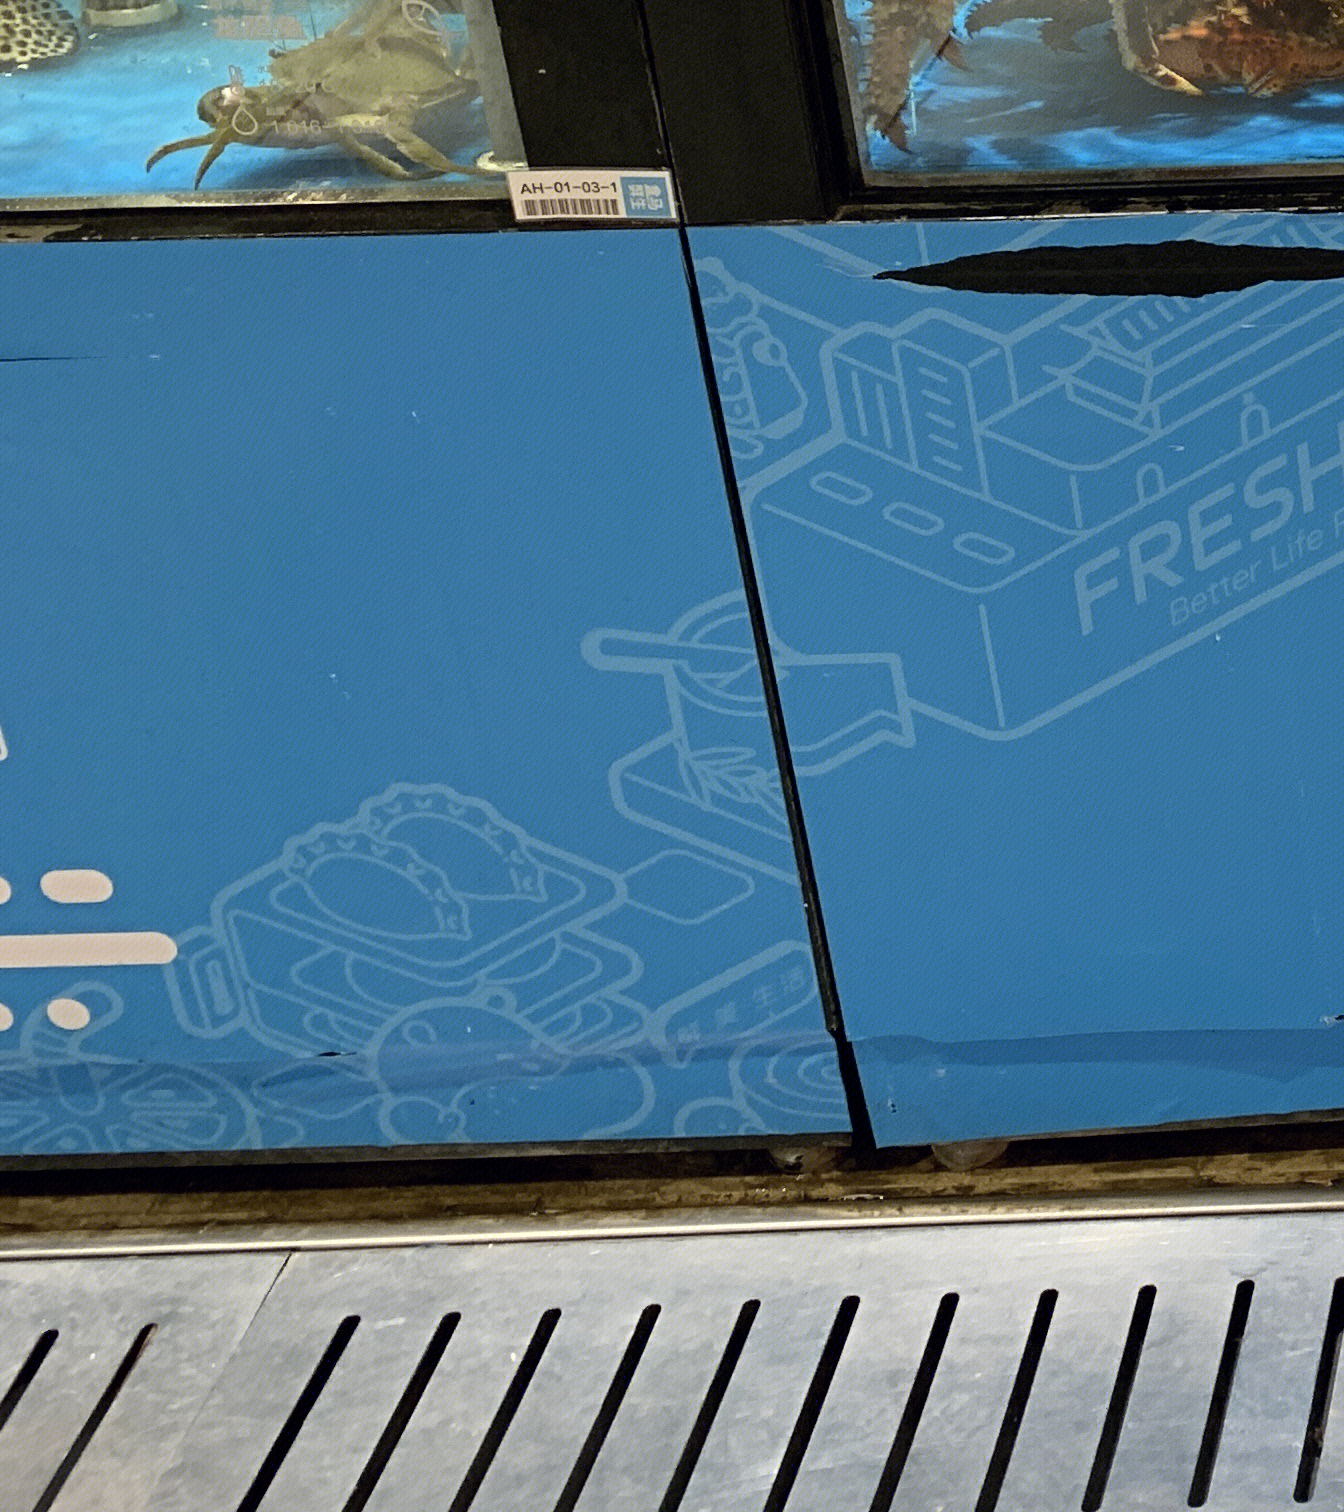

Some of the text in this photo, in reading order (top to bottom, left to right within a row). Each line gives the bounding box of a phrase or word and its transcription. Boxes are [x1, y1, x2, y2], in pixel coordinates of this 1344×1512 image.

[520, 181, 617, 195] AH-01-03-1
[1168, 556, 1262, 628] Better
[1269, 523, 1327, 575] Life
